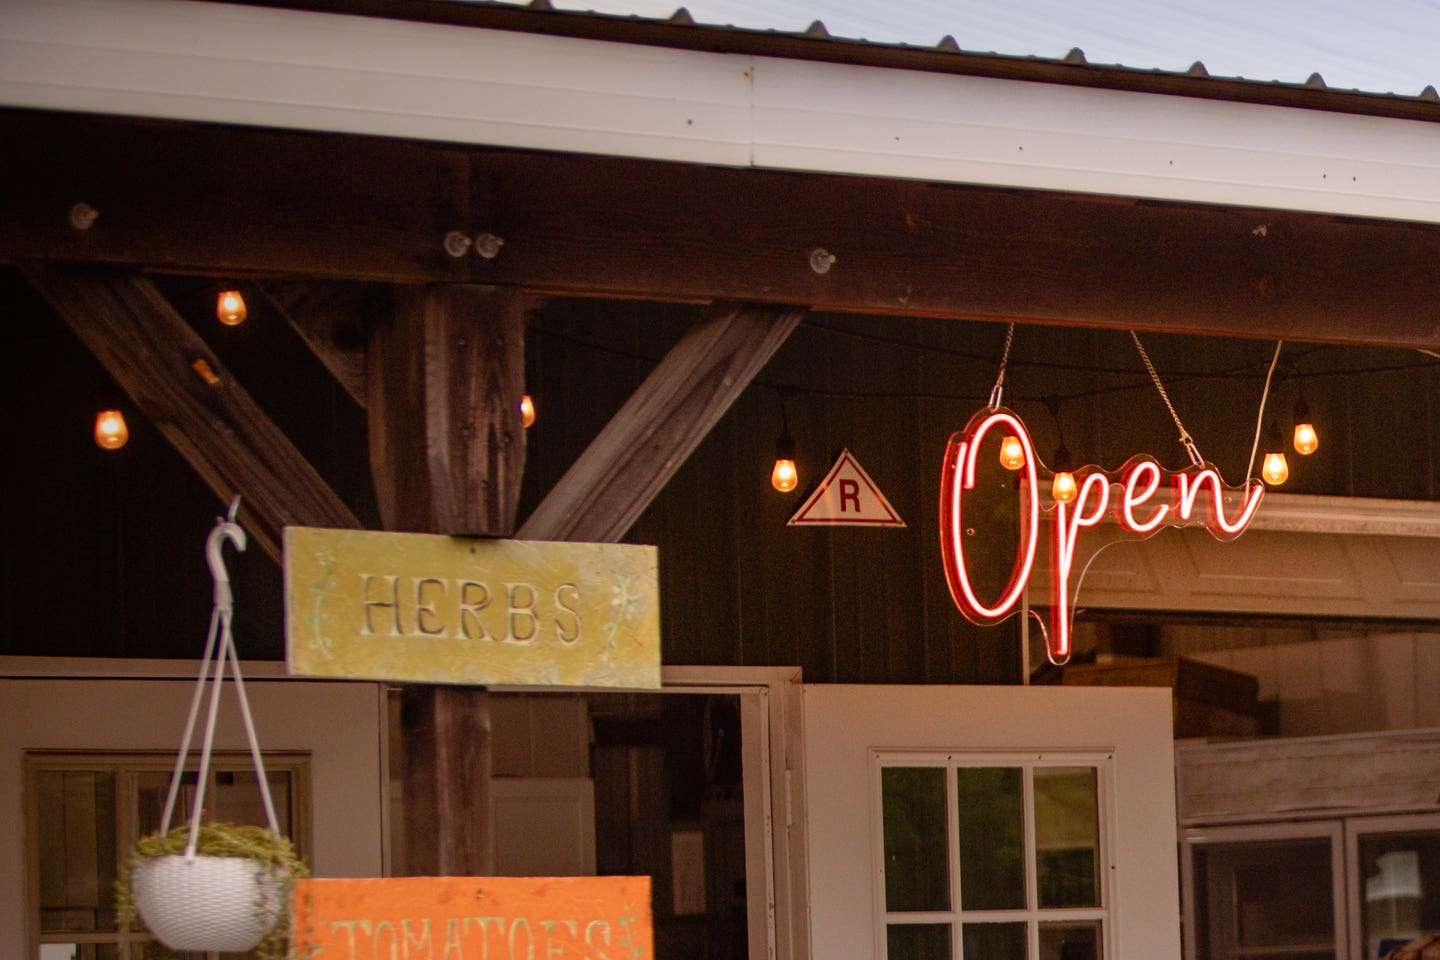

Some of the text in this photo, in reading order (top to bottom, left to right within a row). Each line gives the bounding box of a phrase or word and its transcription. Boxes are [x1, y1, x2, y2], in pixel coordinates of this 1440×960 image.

[840, 479, 861, 513] R
[948, 412, 1266, 656] Open
[357, 573, 583, 647] HERBS
